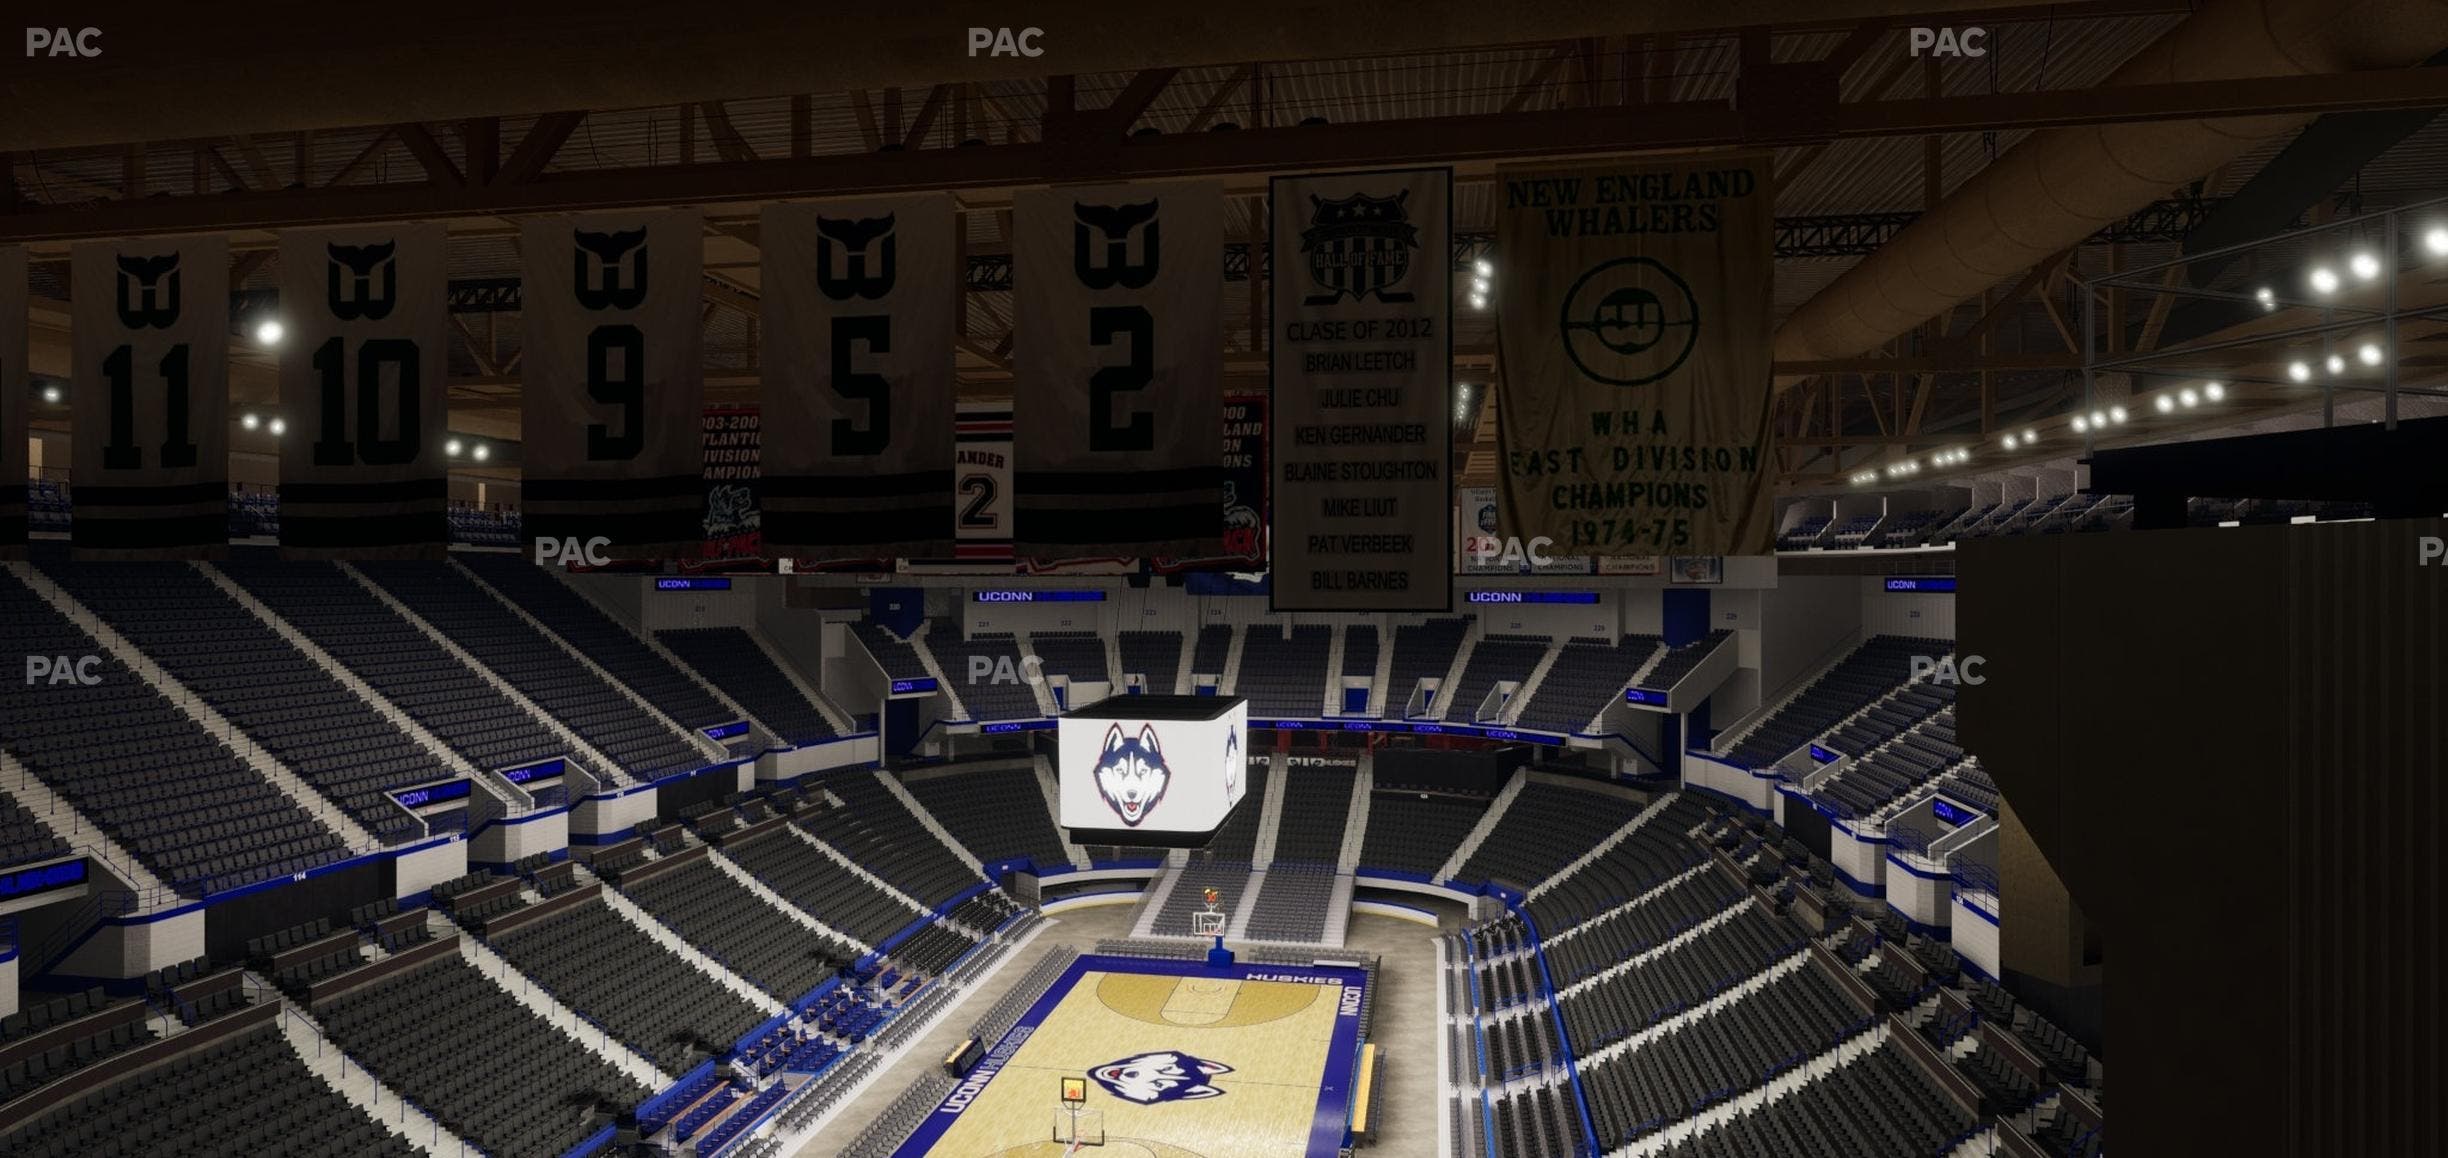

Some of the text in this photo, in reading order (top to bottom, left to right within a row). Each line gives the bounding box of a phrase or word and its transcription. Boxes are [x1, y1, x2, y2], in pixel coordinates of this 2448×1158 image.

[1507, 168, 1755, 209] NEW ENGLAND
[1546, 203, 1718, 237] WHALERS
[1353, 320, 1380, 340] OF
[1385, 318, 1434, 339] 2012
[1306, 351, 1415, 372] BRIAN LEETCH
[831, 315, 891, 456] 5
[1090, 305, 1154, 452] 2
[313, 336, 420, 466] 10
[587, 323, 644, 461] 9
[1321, 388, 1399, 409] JULIE CHU
[102, 343, 198, 469] 11
[1296, 424, 1425, 445] KEN GERNANDER
[957, 450, 1005, 469] ANDER
[1285, 460, 1438, 481] BLAINE STOUGHTON
[1510, 446, 1757, 476] EAST DIVISION
[958, 473, 998, 530] 2
[1552, 481, 1709, 510] CHAMPIONS
[1323, 498, 1397, 517] MIKE LIUT
[1308, 534, 1414, 553] PAT VERBEEK
[1571, 518, 1690, 547] 1974-75
[658, 580, 691, 589] UCONN
[1312, 571, 1409, 590] BILL BARNES
[1887, 580, 1916, 589] UCONN
[979, 592, 1033, 602] UCONN
[1470, 592, 1522, 603] UCONN
[1246, 973, 1344, 985] HUSKIES
[1339, 986, 1363, 1016] UCONN
[939, 1069, 998, 1114] UCONN
